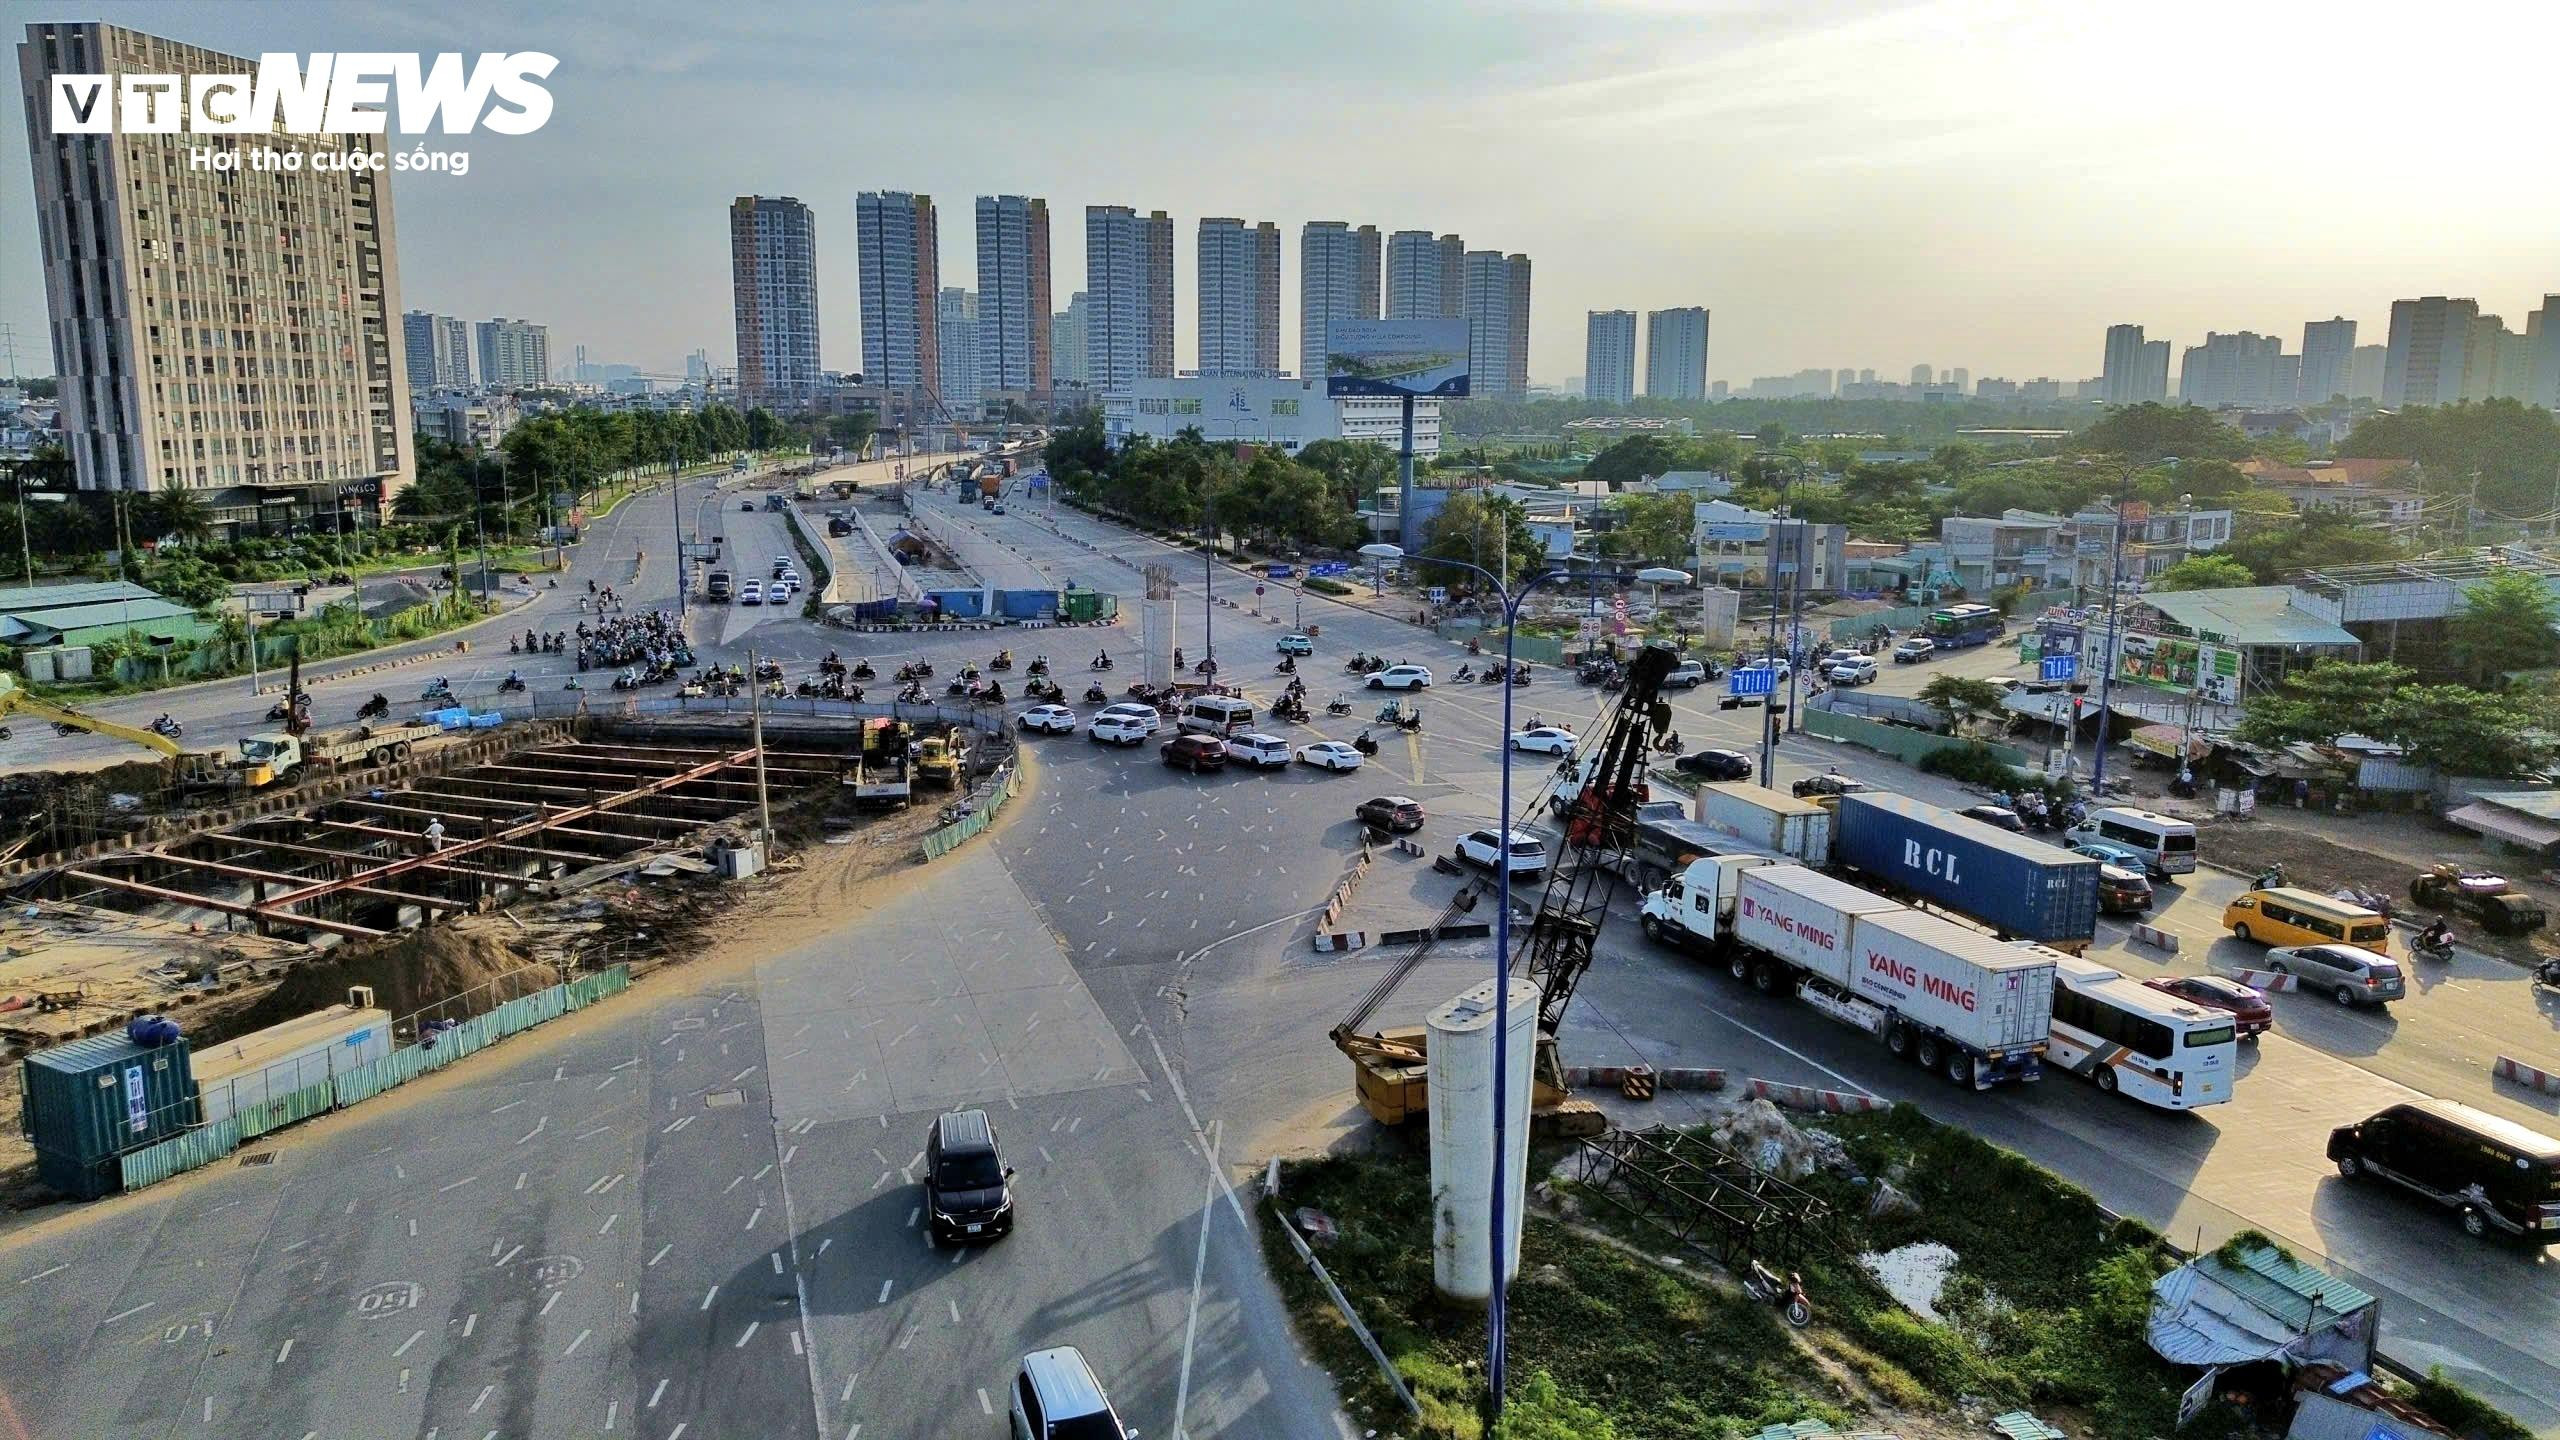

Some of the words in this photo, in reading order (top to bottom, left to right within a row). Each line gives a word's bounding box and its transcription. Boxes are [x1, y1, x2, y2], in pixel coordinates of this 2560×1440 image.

[1220, 369, 1265, 378] INTERNATIONAL
[1268, 370, 1292, 378] SCHOOL
[1903, 838, 1960, 885] RCL
[2047, 879, 2067, 889] RCL
[1757, 904, 1793, 933] YANG
[1796, 922, 1834, 951] MING
[1867, 949, 1916, 988] YANG
[1923, 973, 1975, 1013] MING
